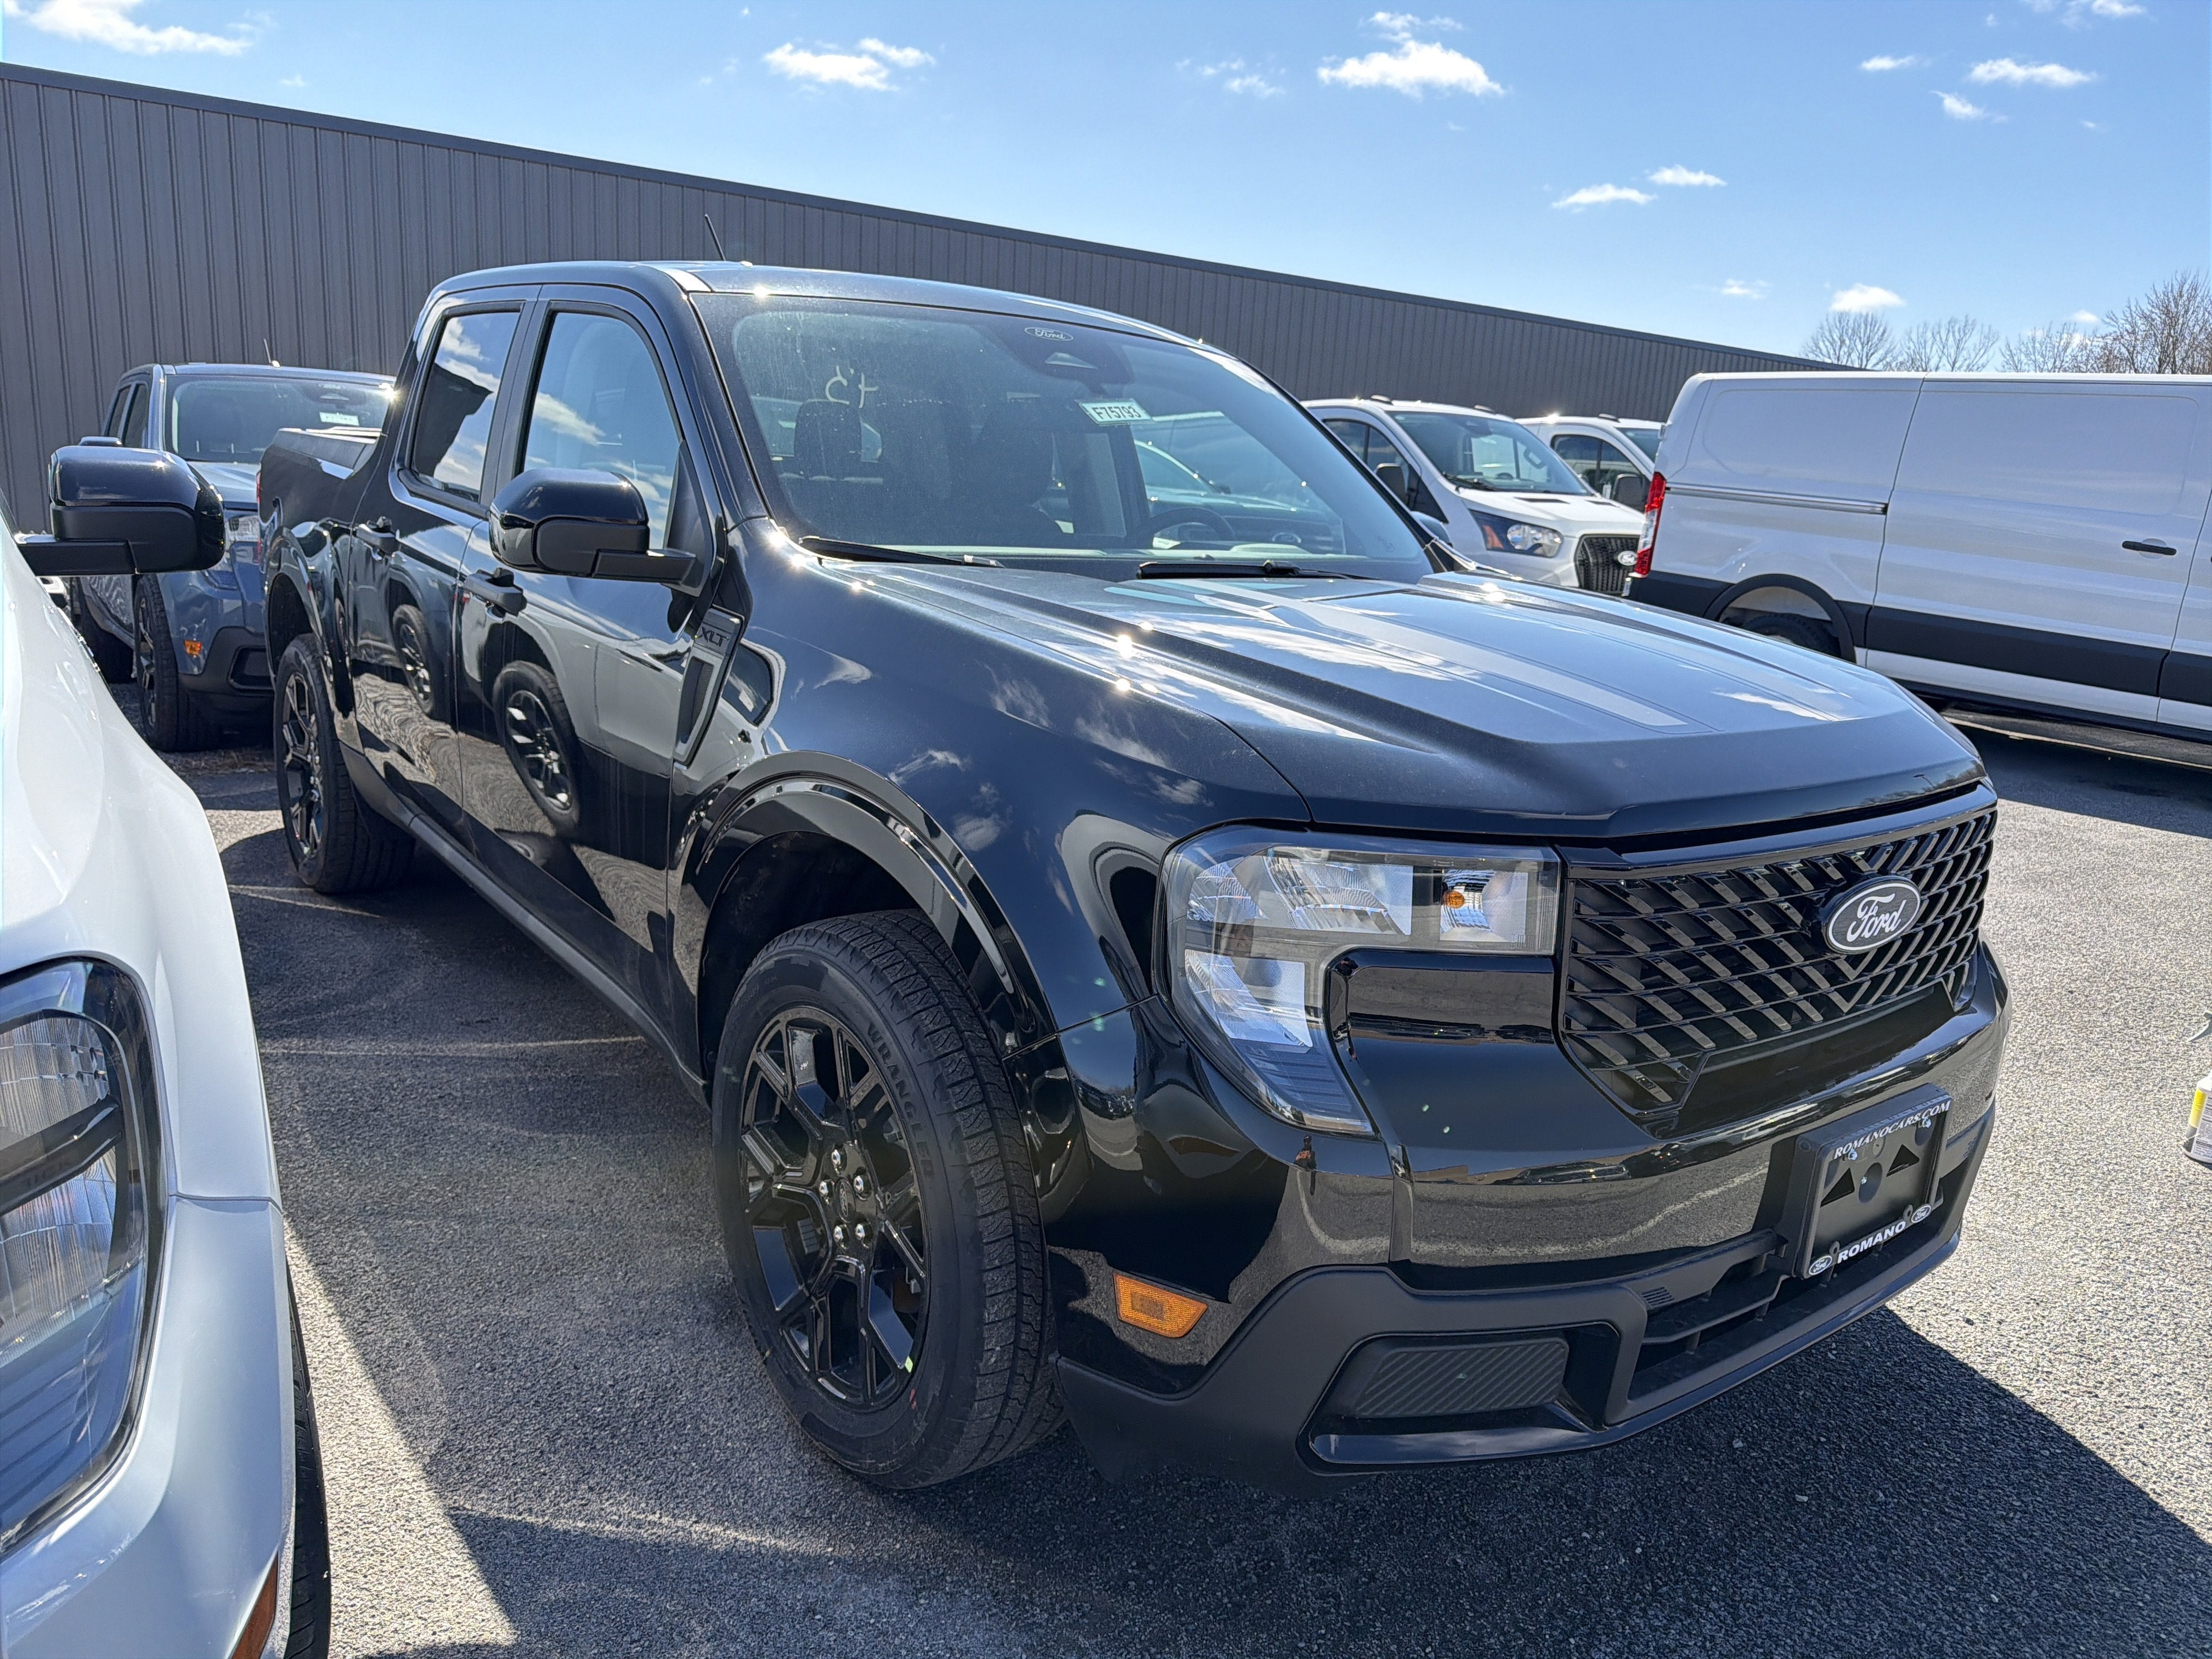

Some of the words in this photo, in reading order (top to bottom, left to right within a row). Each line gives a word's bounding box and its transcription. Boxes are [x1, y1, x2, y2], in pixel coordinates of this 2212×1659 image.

[1034, 328, 1066, 340] Ford
[1091, 406, 1142, 420] F75793
[699, 627, 729, 647] XLT
[1847, 893, 1906, 942] Ford
[867, 1022, 935, 1177] WRANGLER
[1833, 1101, 1951, 1160] ROMANOCARS.COM
[1836, 1220, 1906, 1265] ROMANO
